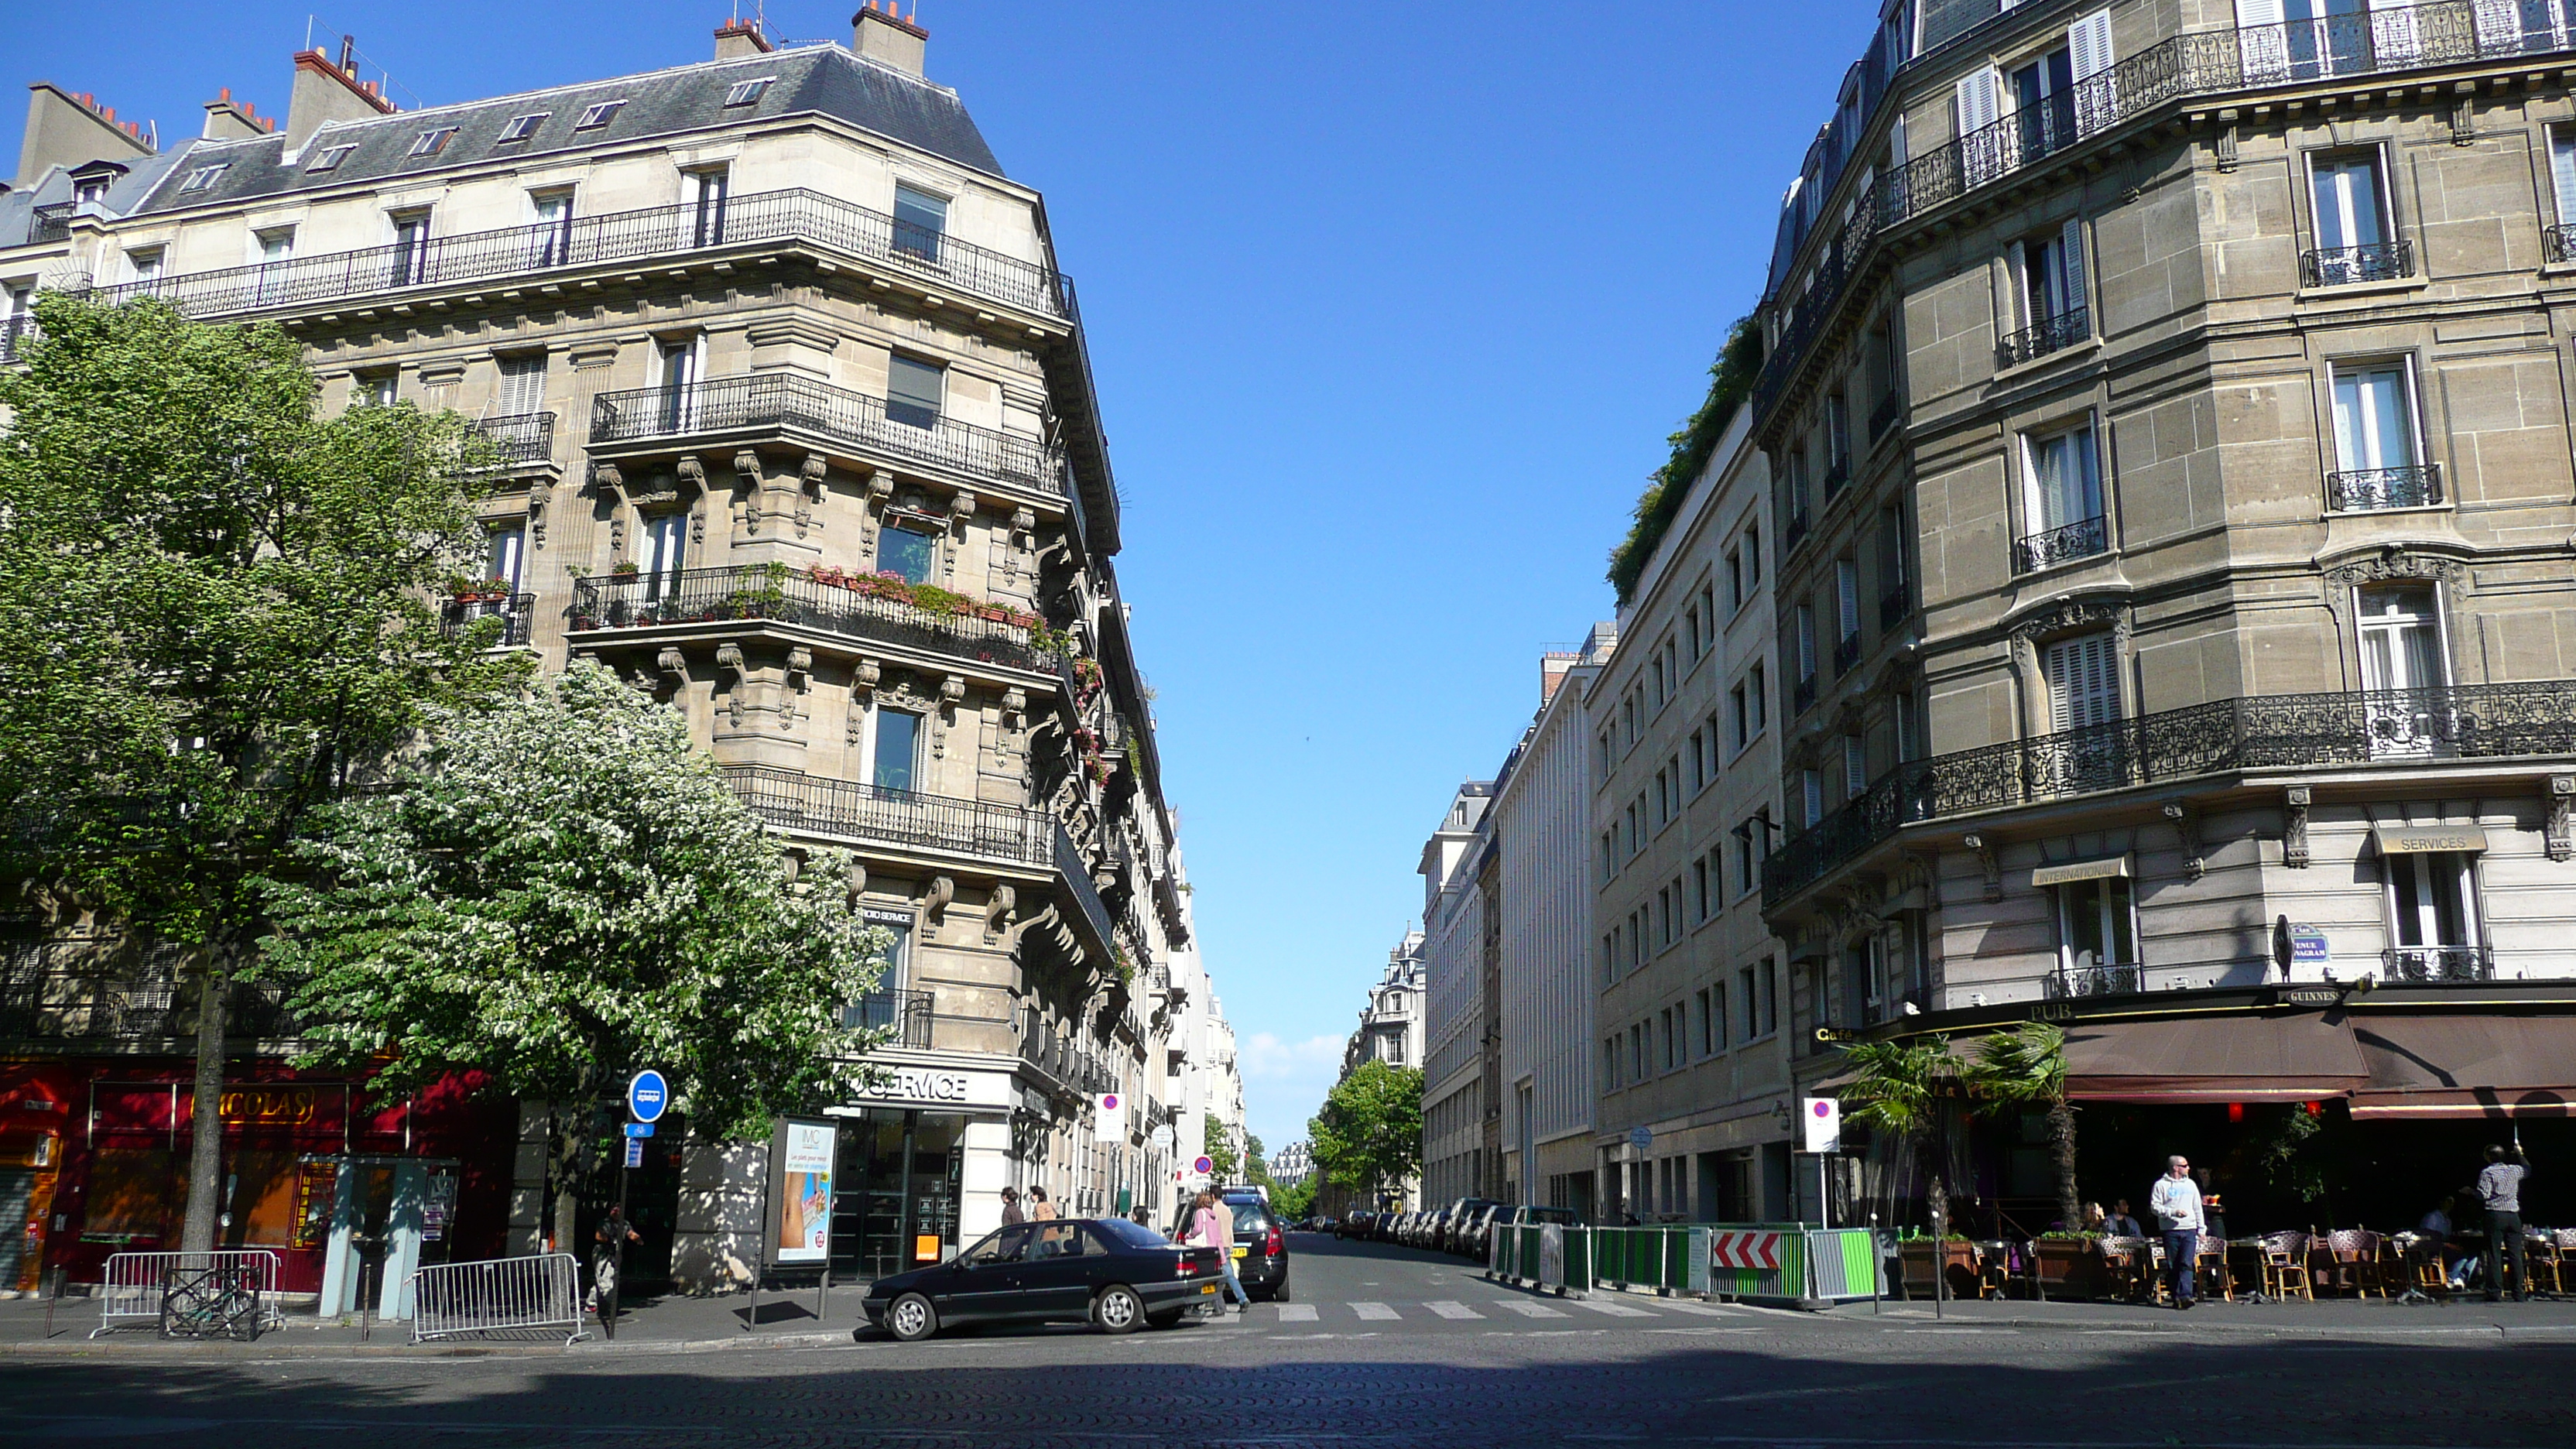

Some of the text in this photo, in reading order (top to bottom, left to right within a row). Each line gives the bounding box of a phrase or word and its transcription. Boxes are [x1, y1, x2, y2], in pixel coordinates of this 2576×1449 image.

[2401, 837, 2466, 850] SERVICES
[2039, 865, 2113, 883] INTERNATIONAL
[864, 909, 911, 923] OTO SERVICE
[2031, 1004, 2072, 1021] PUB
[1816, 1028, 1853, 1041] Café
[219, 1092, 307, 1116] ICOLAS
